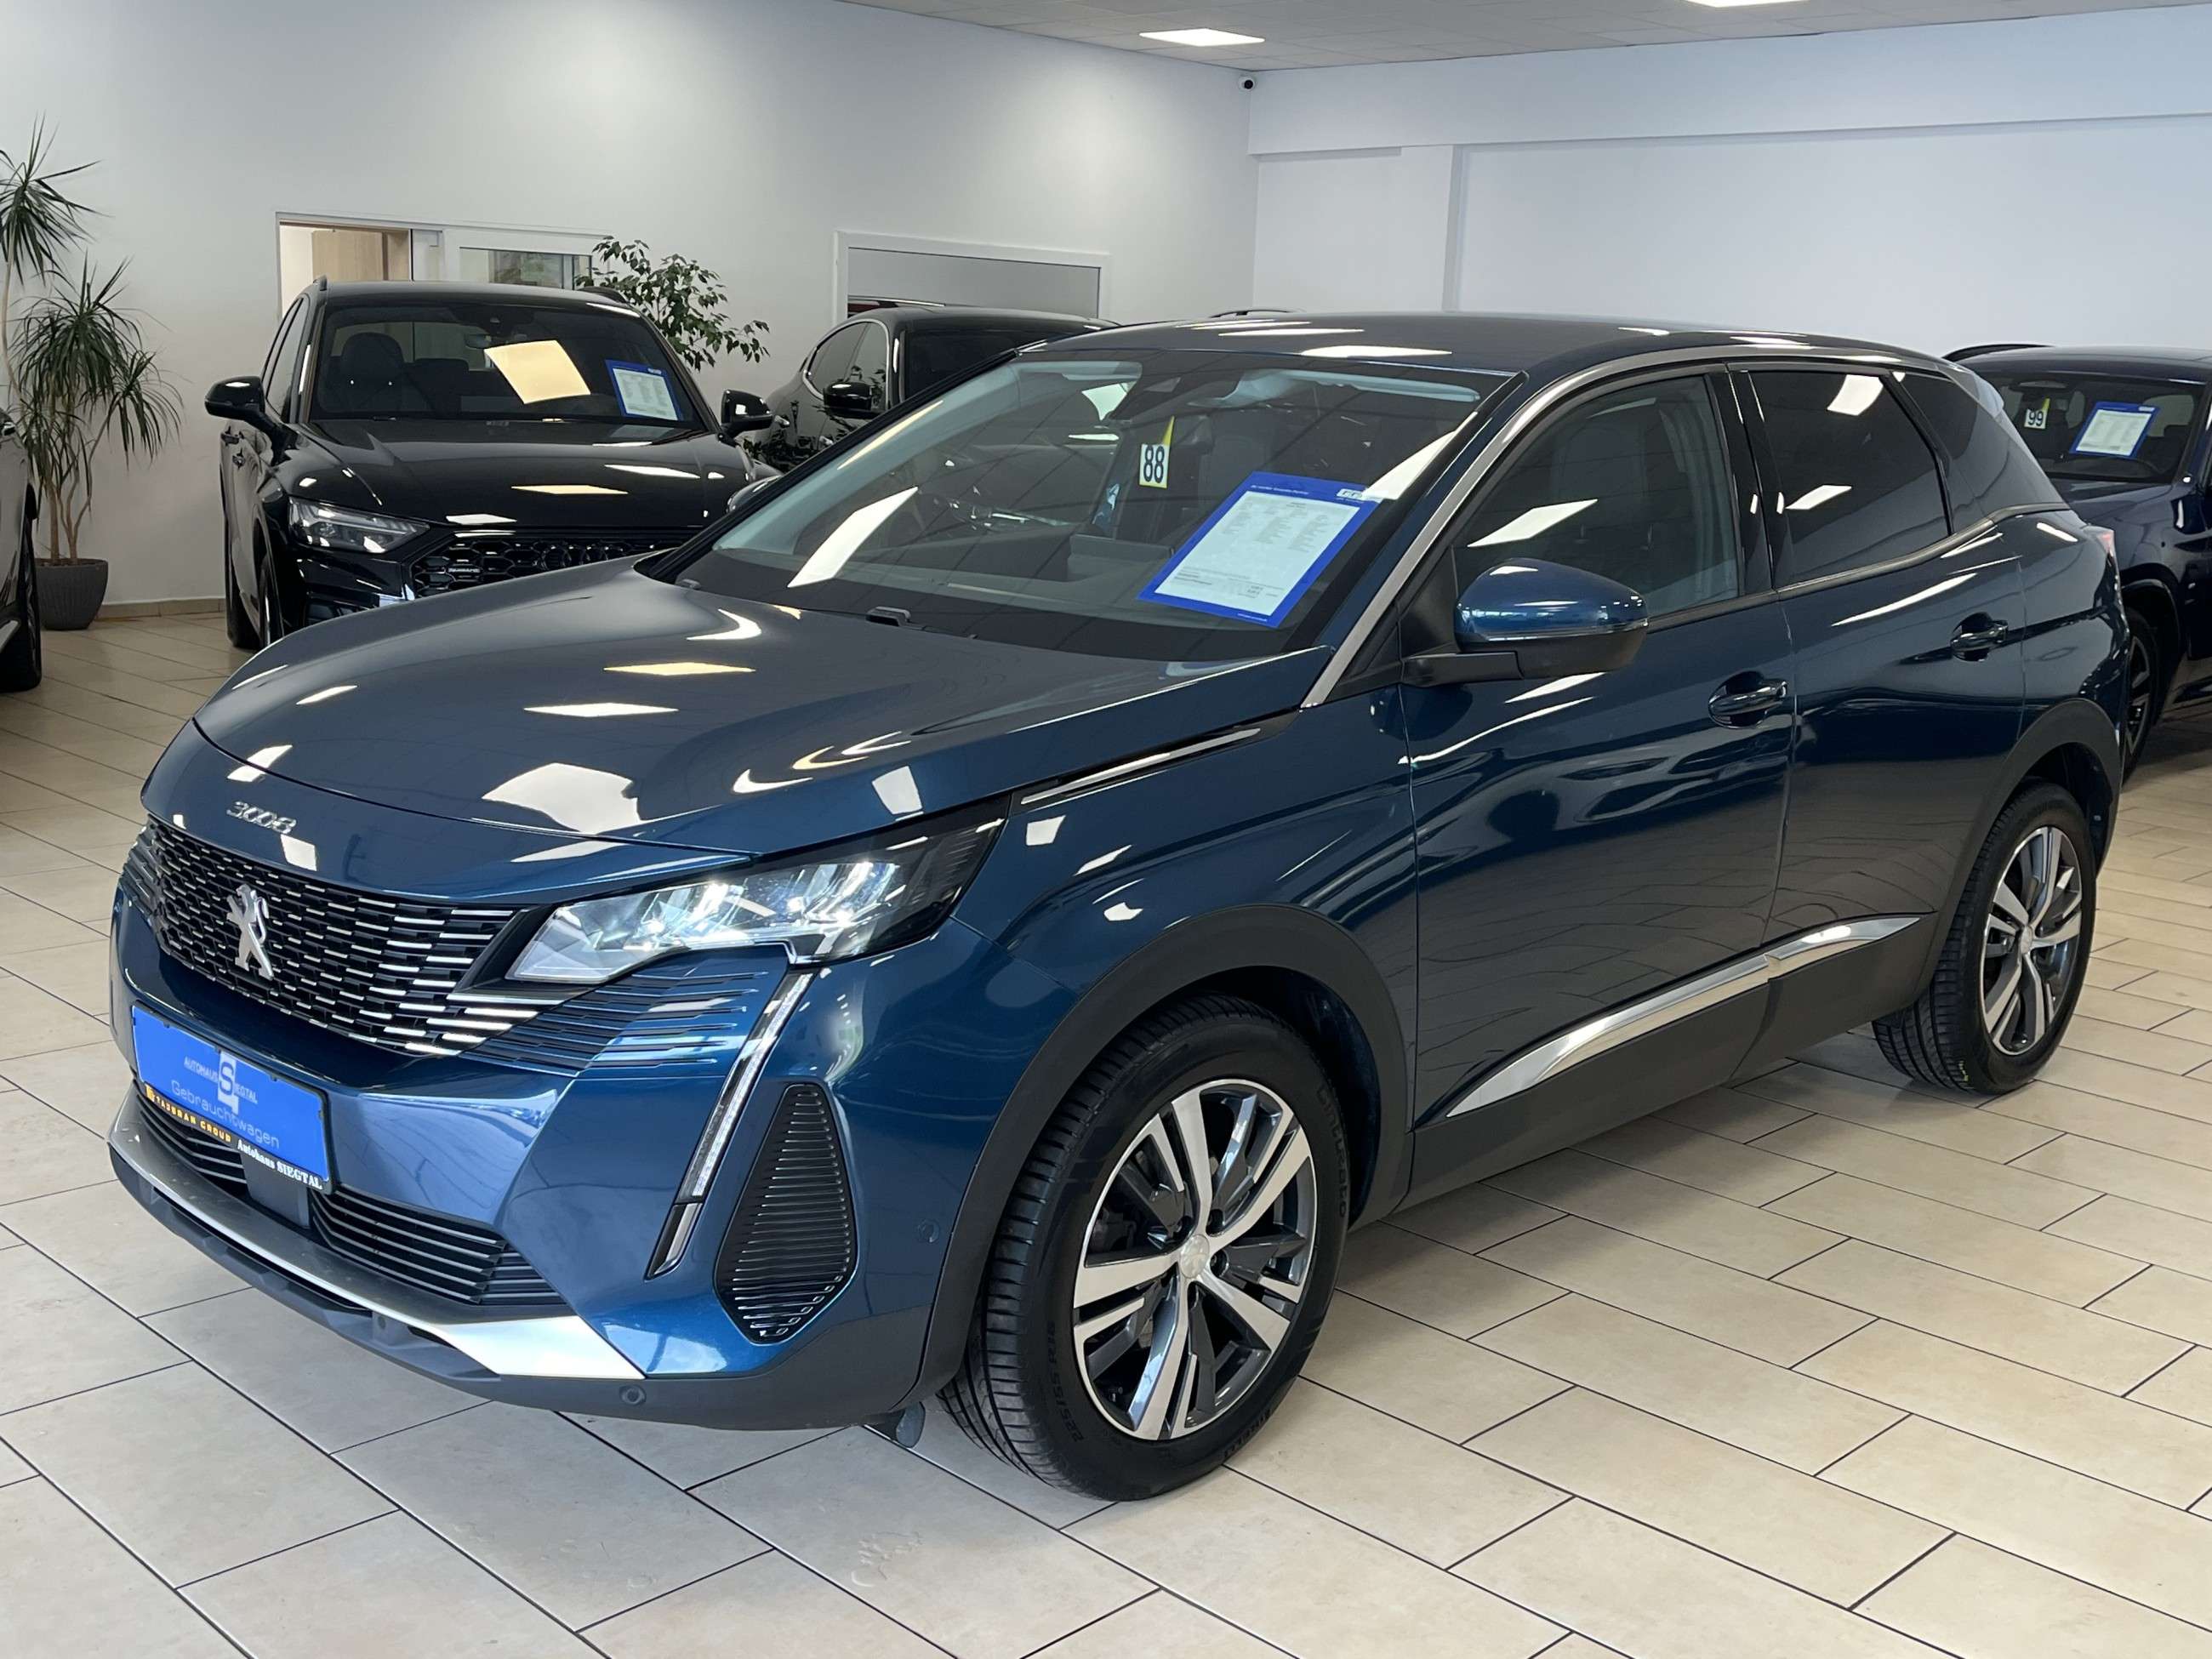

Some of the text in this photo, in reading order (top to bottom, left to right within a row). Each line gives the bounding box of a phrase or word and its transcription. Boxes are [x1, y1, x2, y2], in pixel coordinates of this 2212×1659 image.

[2028, 409, 2044, 426] 99
[1143, 445, 1165, 483] 88
[226, 801, 297, 834] 3008
[183, 1056, 219, 1084] AUTOHAUS
[171, 1079, 280, 1149] Gebrauchtwagen
[200, 1120, 231, 1143] GROUP
[237, 1138, 323, 1190] Autohaus SIEGTAL
